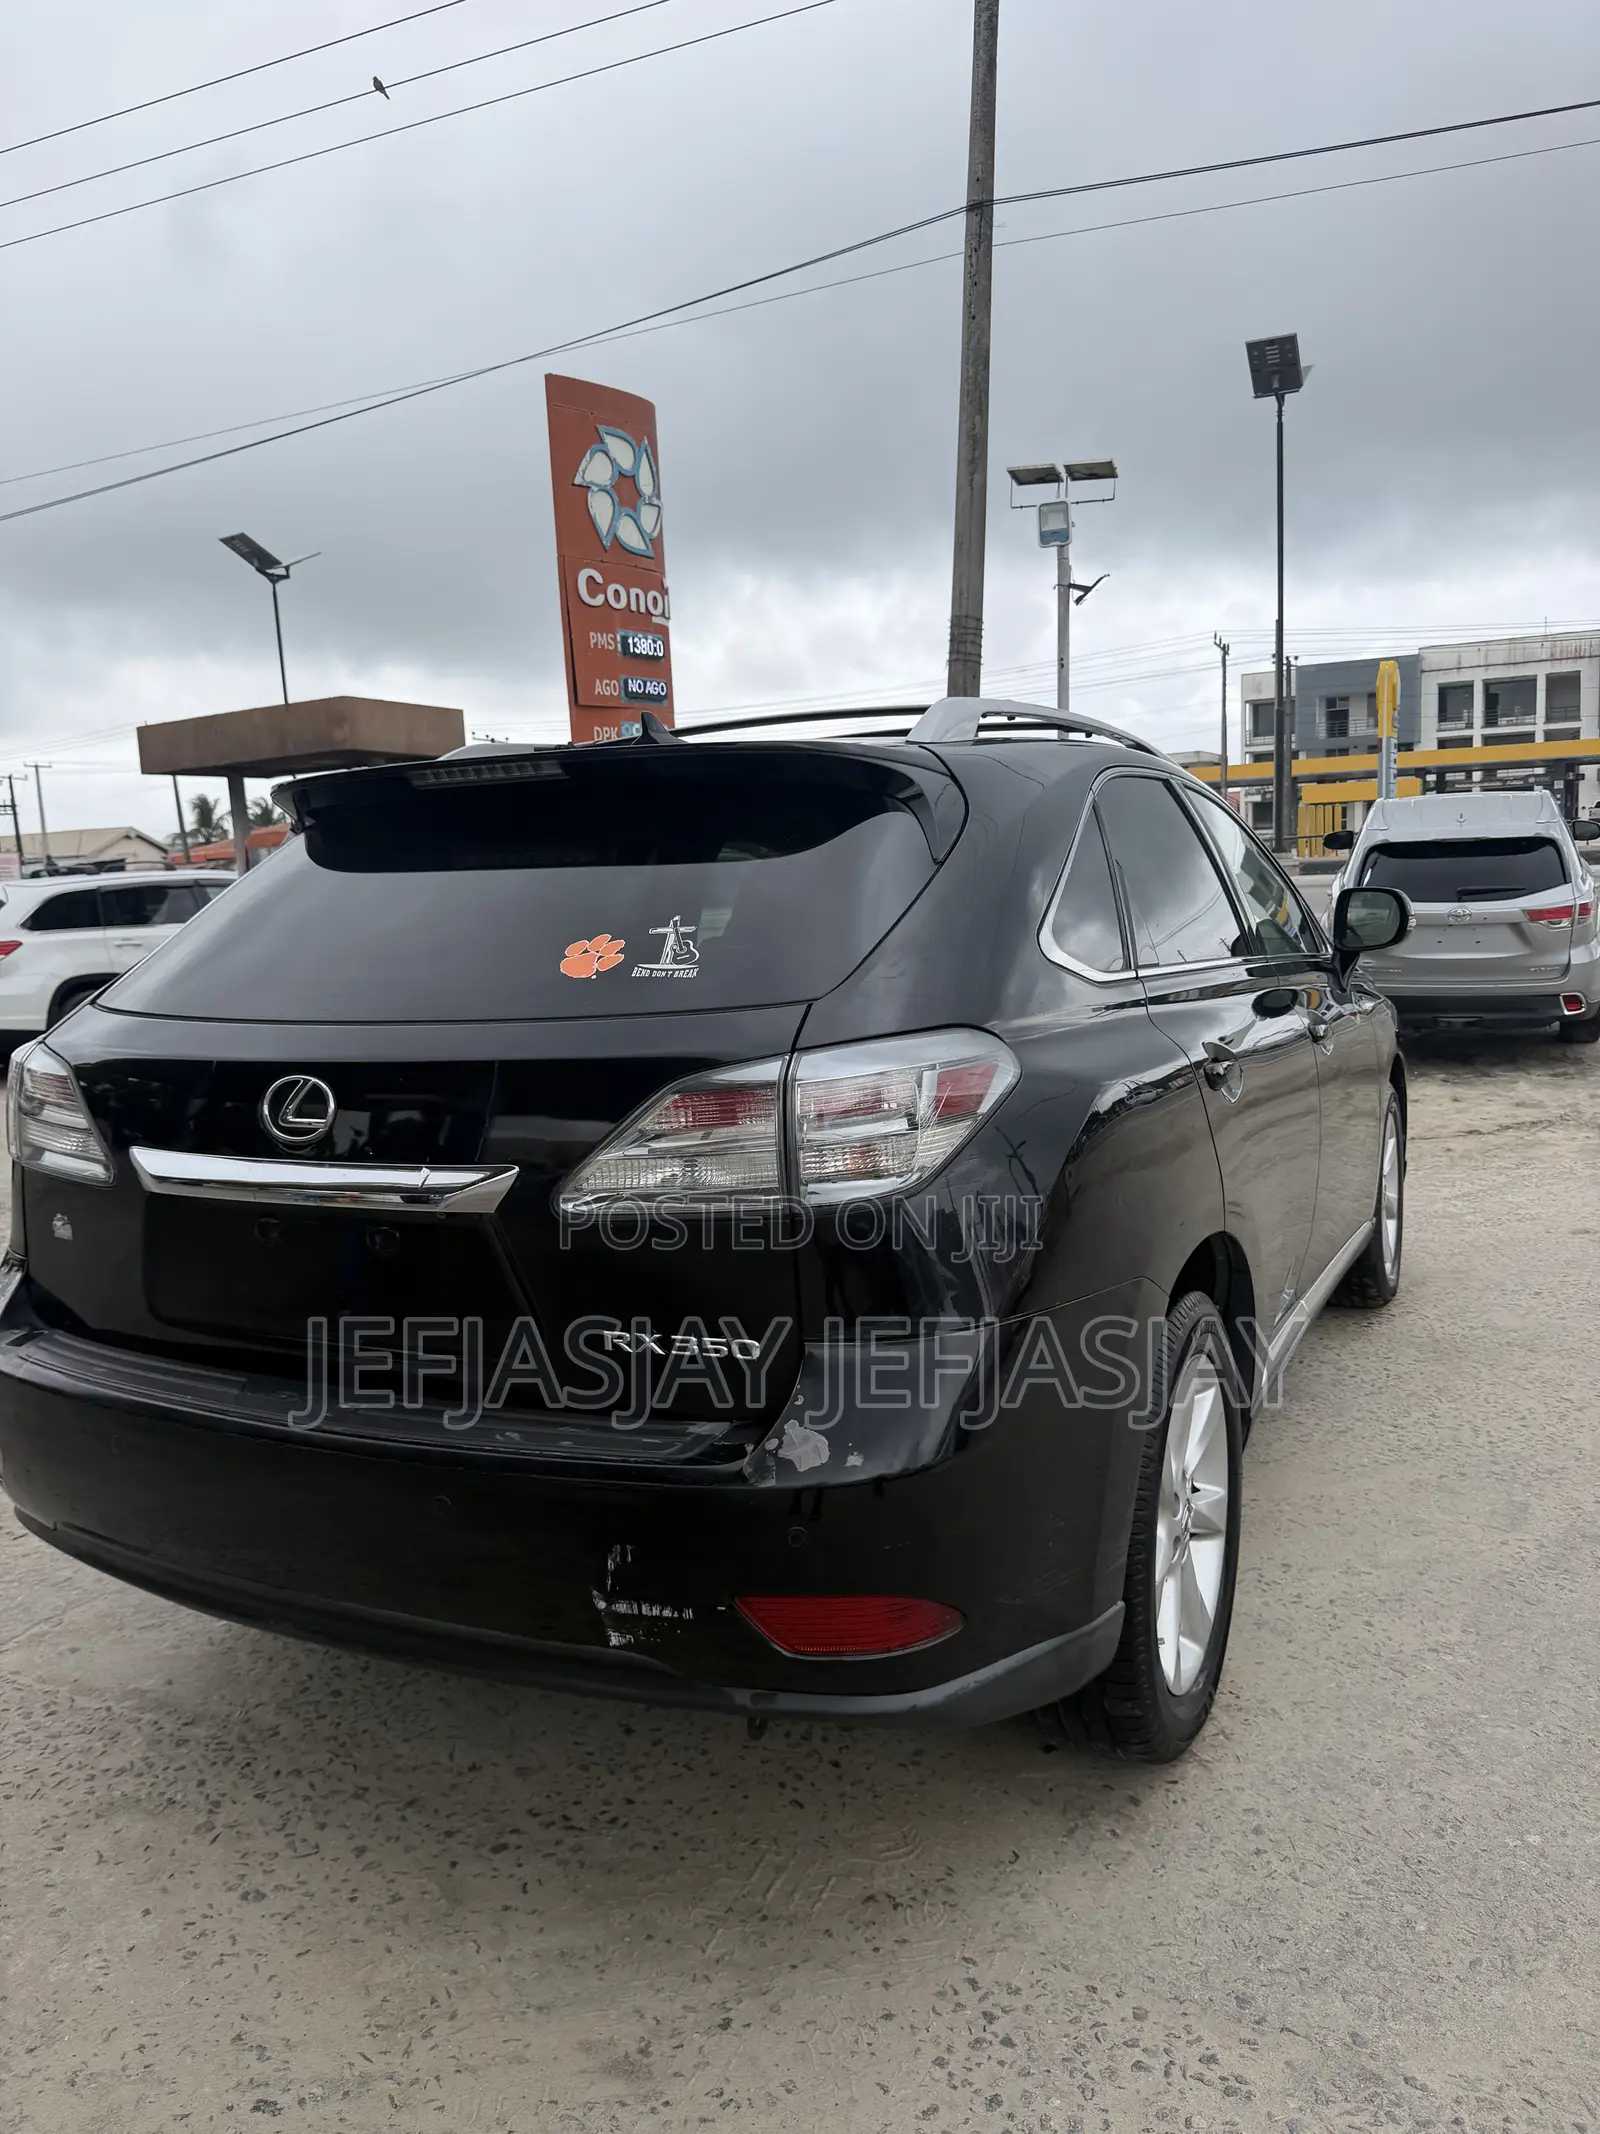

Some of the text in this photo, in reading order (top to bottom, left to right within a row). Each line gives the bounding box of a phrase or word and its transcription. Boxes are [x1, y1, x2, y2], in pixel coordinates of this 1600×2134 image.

[589, 631, 616, 650] PMS
[595, 678, 667, 696] AGO NO AGO
[593, 726, 619, 741] DPK
[631, 966, 651, 977] BEND
[673, 968, 700, 979] BREAK
[603, 1330, 761, 1360] RX 350
